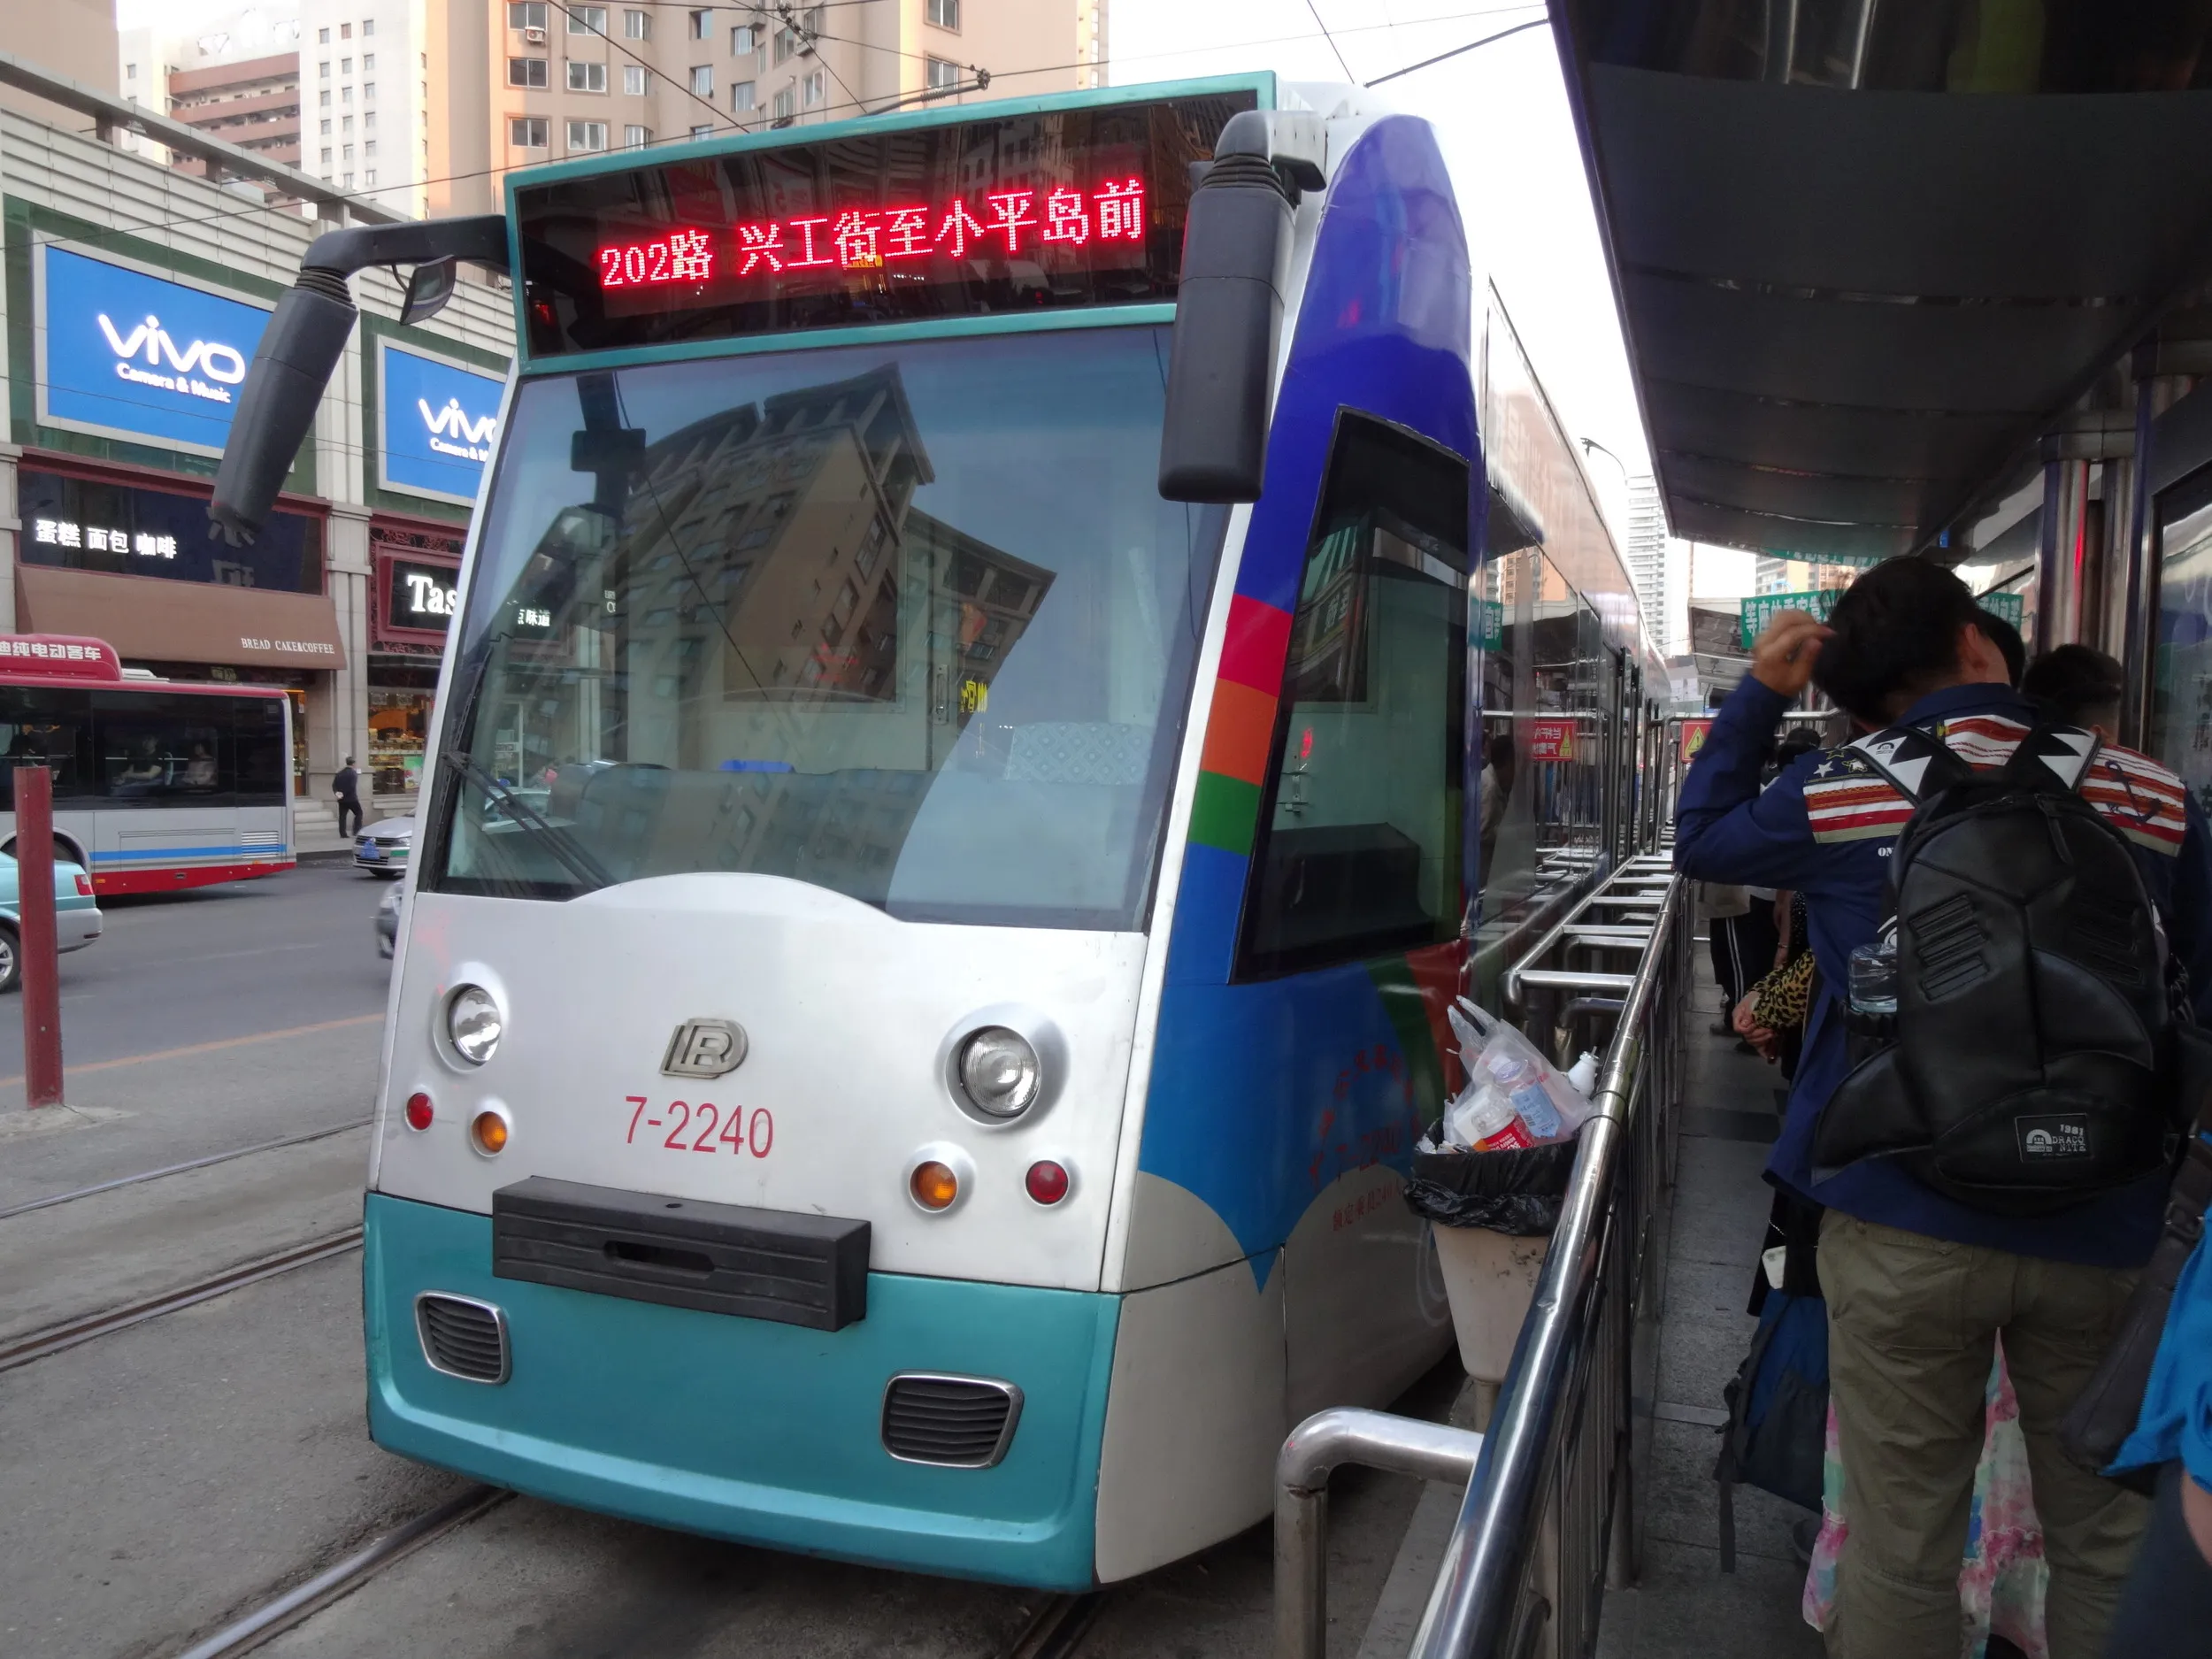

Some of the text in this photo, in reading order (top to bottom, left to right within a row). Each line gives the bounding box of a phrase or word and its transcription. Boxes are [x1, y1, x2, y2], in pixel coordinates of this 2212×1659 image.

[601, 180, 1146, 288] 202路 兴工街至小平岛前
[98, 314, 246, 384] vivo
[116, 362, 175, 390] Camera
[190, 380, 232, 403] Music
[35, 518, 178, 559] 蛋糕 面包 咖啡
[241, 637, 271, 650] BREAD
[626, 1095, 773, 1159] 7-2240
